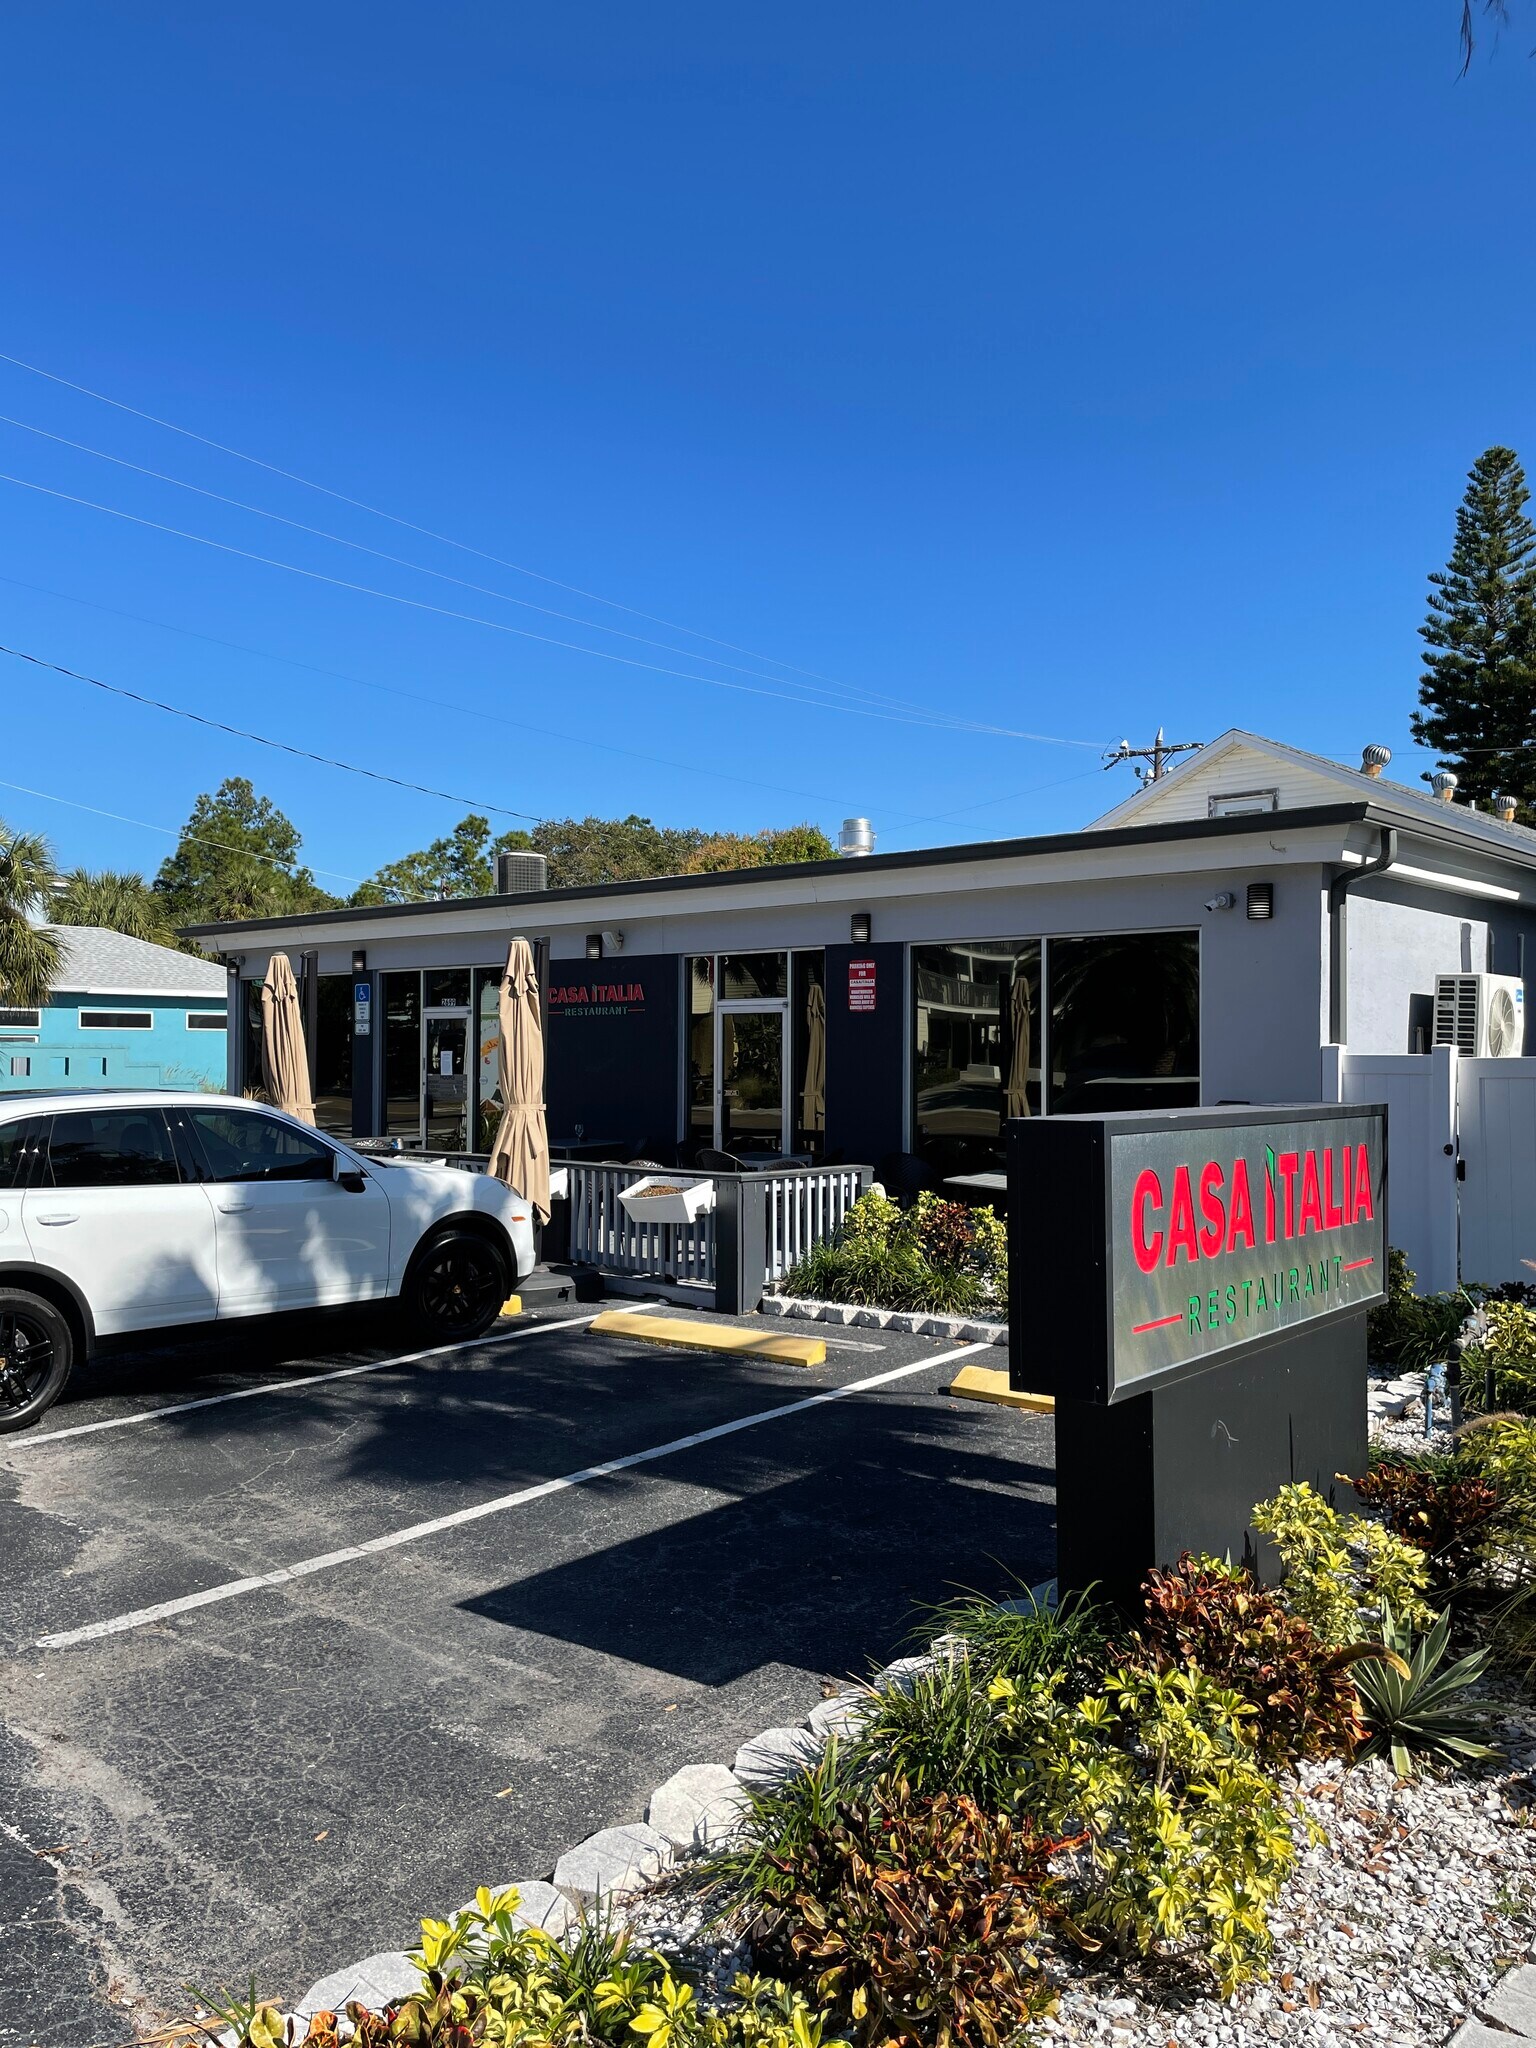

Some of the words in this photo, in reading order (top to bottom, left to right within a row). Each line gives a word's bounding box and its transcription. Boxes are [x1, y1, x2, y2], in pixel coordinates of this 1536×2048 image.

[548, 986, 589, 1004] CASA
[591, 984, 645, 1003] ITALIA
[564, 1006, 628, 1016] RESTAURANT
[1131, 1158, 1256, 1275] CASA
[1265, 1143, 1374, 1244] ITALIA
[1187, 1255, 1343, 1336] RESTAURANT
